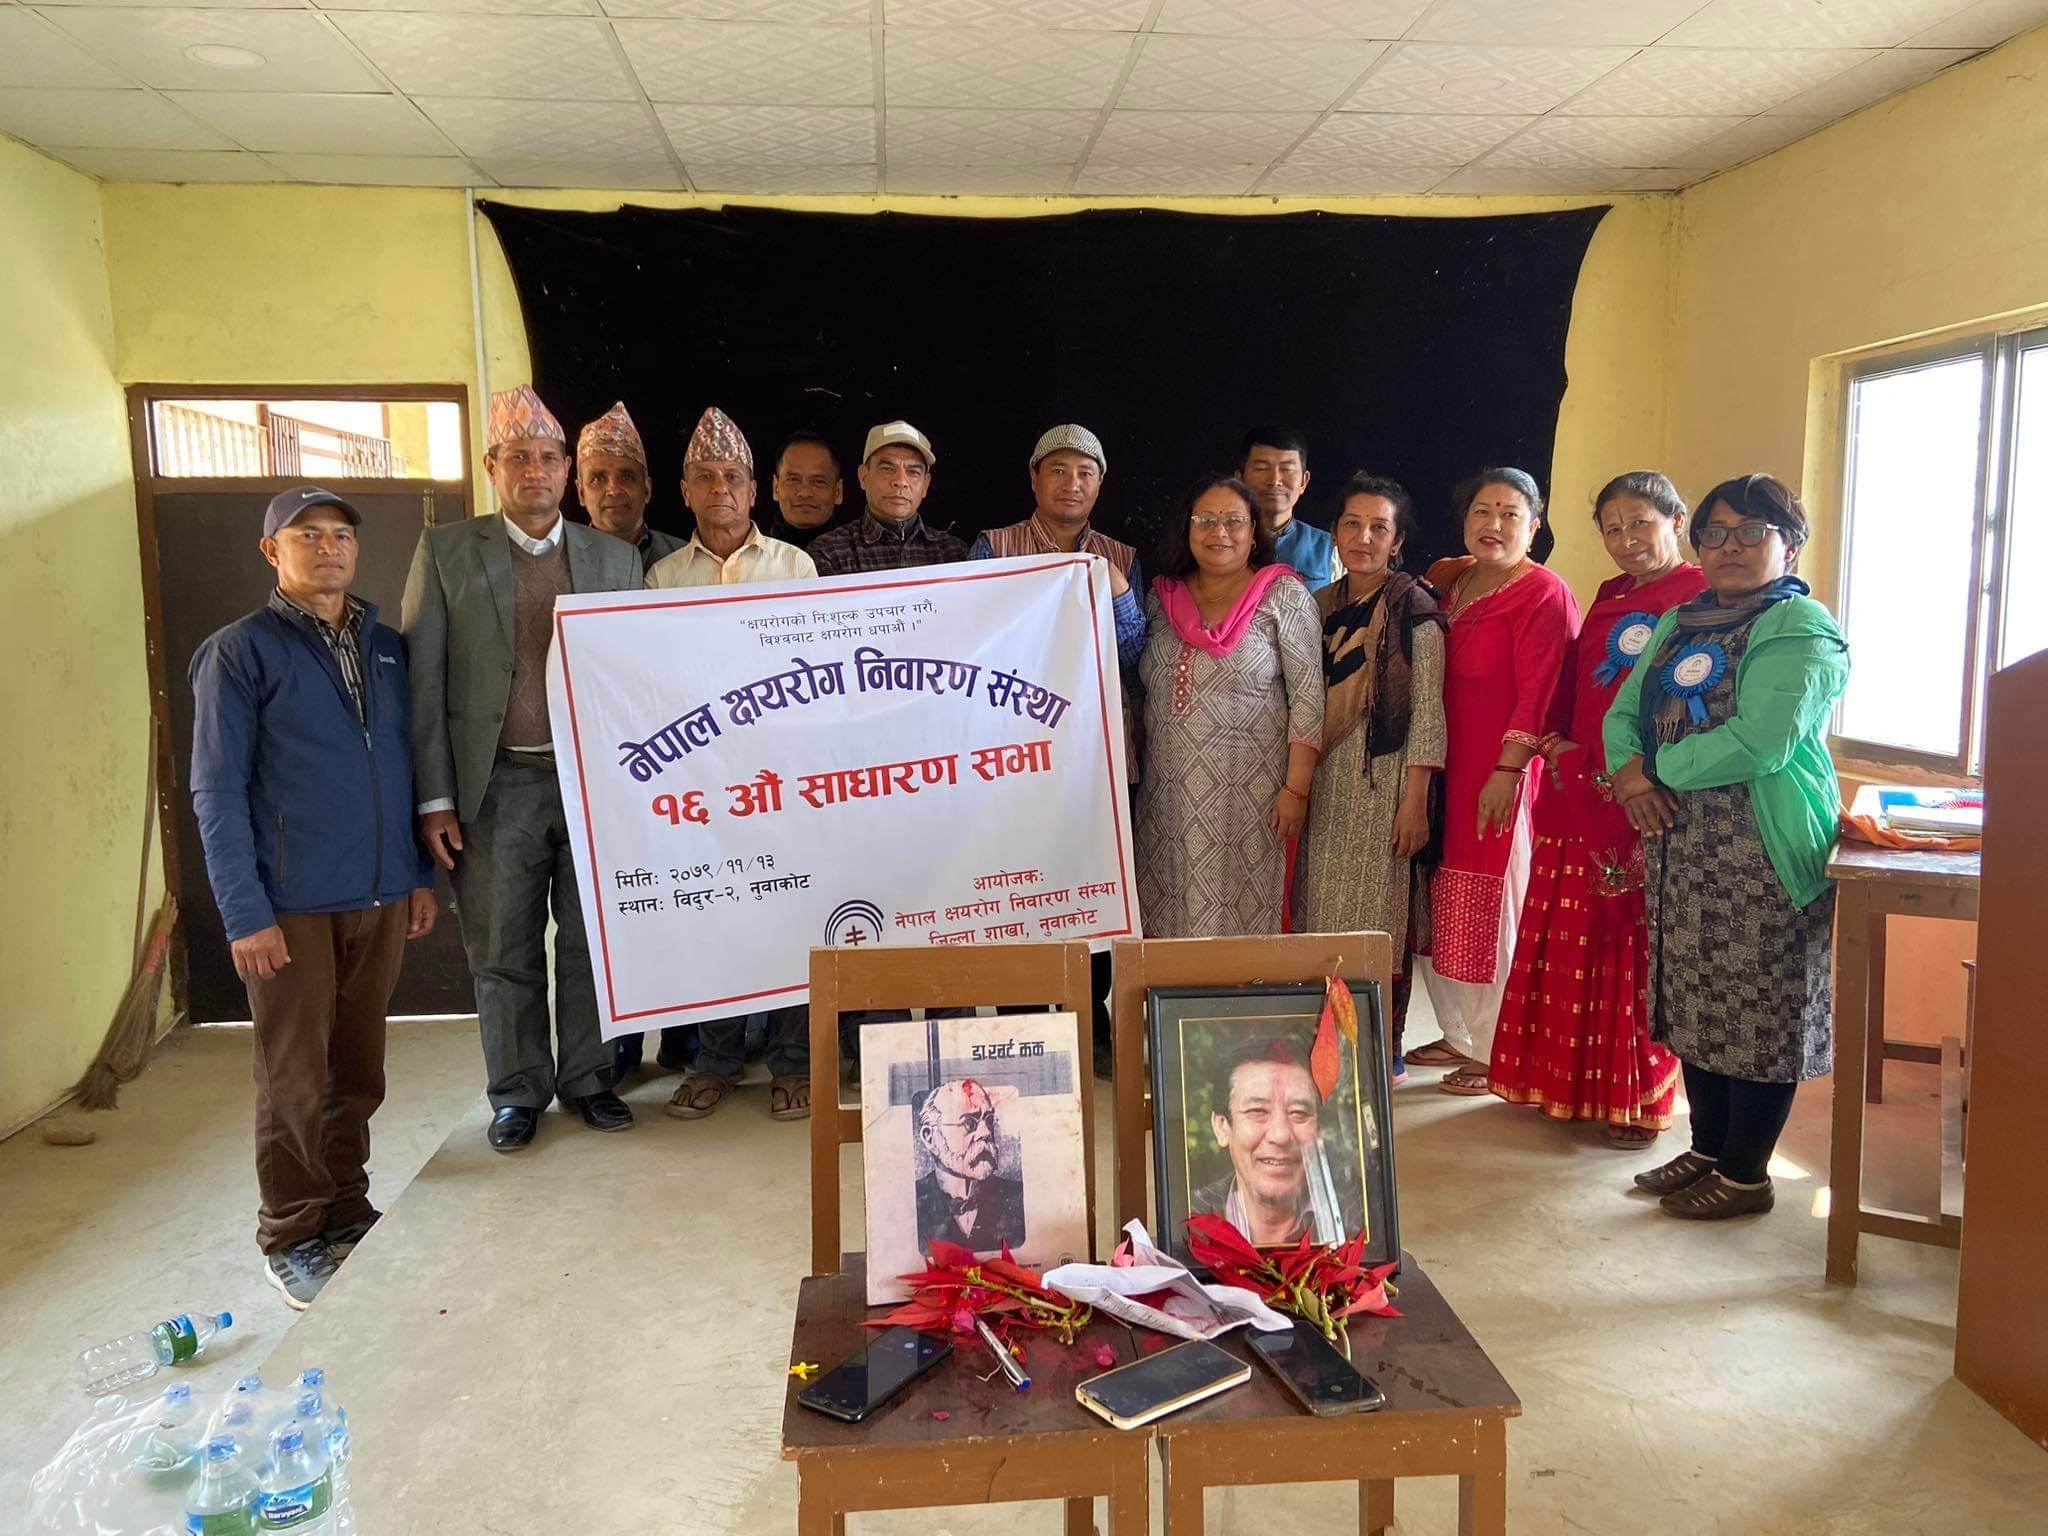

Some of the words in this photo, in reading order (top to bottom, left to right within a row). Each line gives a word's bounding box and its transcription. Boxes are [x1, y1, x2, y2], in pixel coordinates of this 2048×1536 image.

[865, 605, 906, 619] उपचार
[821, 625, 862, 640] क्षयरोग
[617, 702, 722, 782] नेपाल
[720, 657, 846, 726] क्षयरोग
[854, 646, 982, 698] निवारण
[987, 669, 1072, 729] संस्था
[651, 790, 711, 825] १६
[797, 753, 959, 809] साधारण
[970, 740, 1053, 781] सभा
[749, 873, 811, 901] नुवाकोट
[895, 909, 937, 929] नेपाल
[945, 898, 1001, 922] क्षयरोग
[1009, 888, 1070, 912] निवारण
[1078, 882, 1117, 900] संस्था
[984, 921, 1030, 941] शाखा,
[1039, 908, 1098, 936] नुवाकोट
